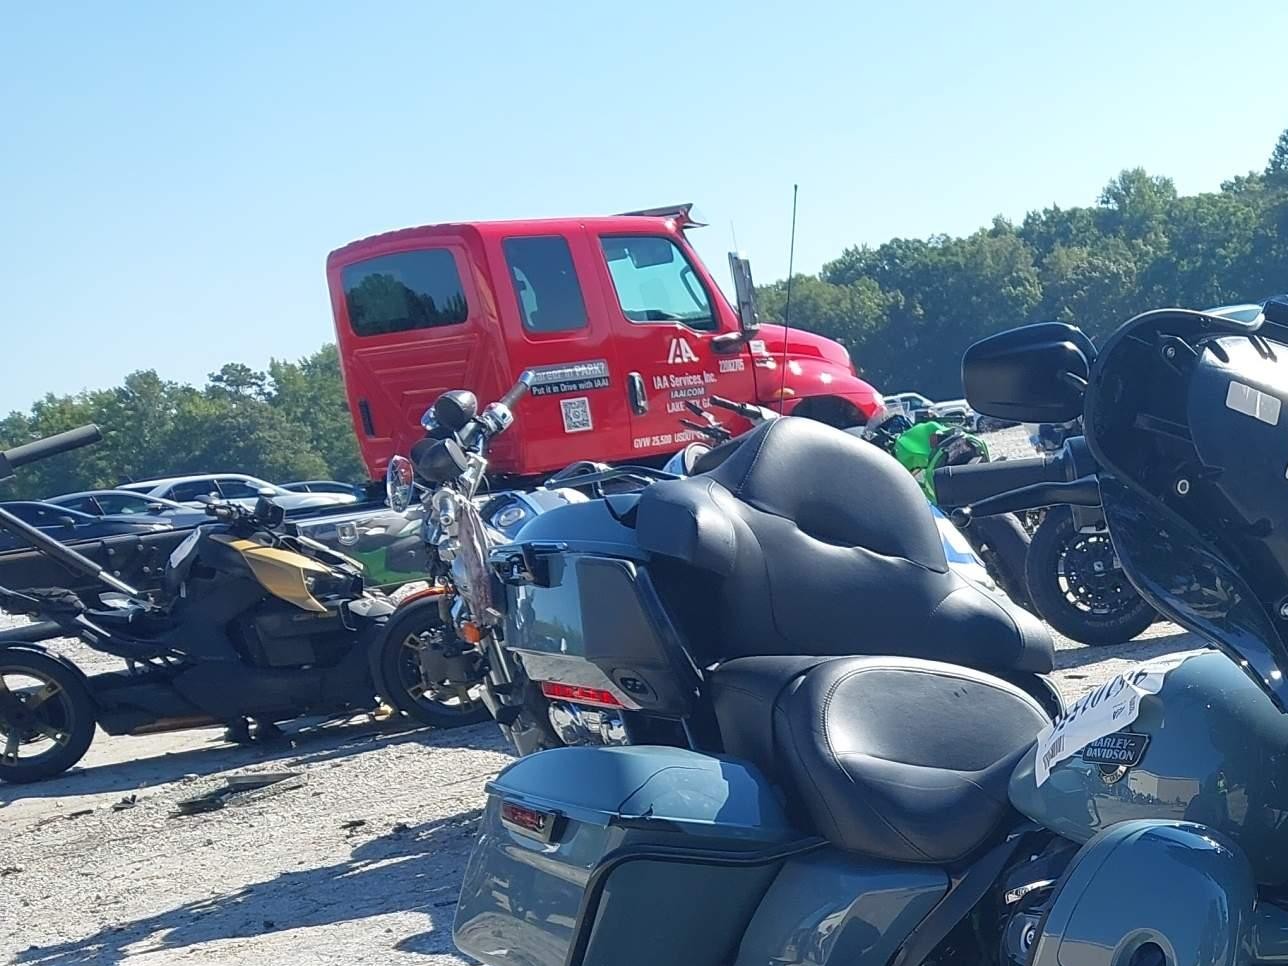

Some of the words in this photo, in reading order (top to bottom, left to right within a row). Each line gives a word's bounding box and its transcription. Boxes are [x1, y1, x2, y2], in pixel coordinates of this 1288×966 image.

[534, 369, 562, 382] areer
[652, 375, 670, 390] IAA
[669, 372, 704, 388] Services,
[702, 370, 718, 385] Inc.
[560, 382, 578, 393] Drive
[666, 400, 686, 413] LAKE
[633, 437, 652, 449] GVW
[1086, 747, 1135, 760] DAVIDSON
